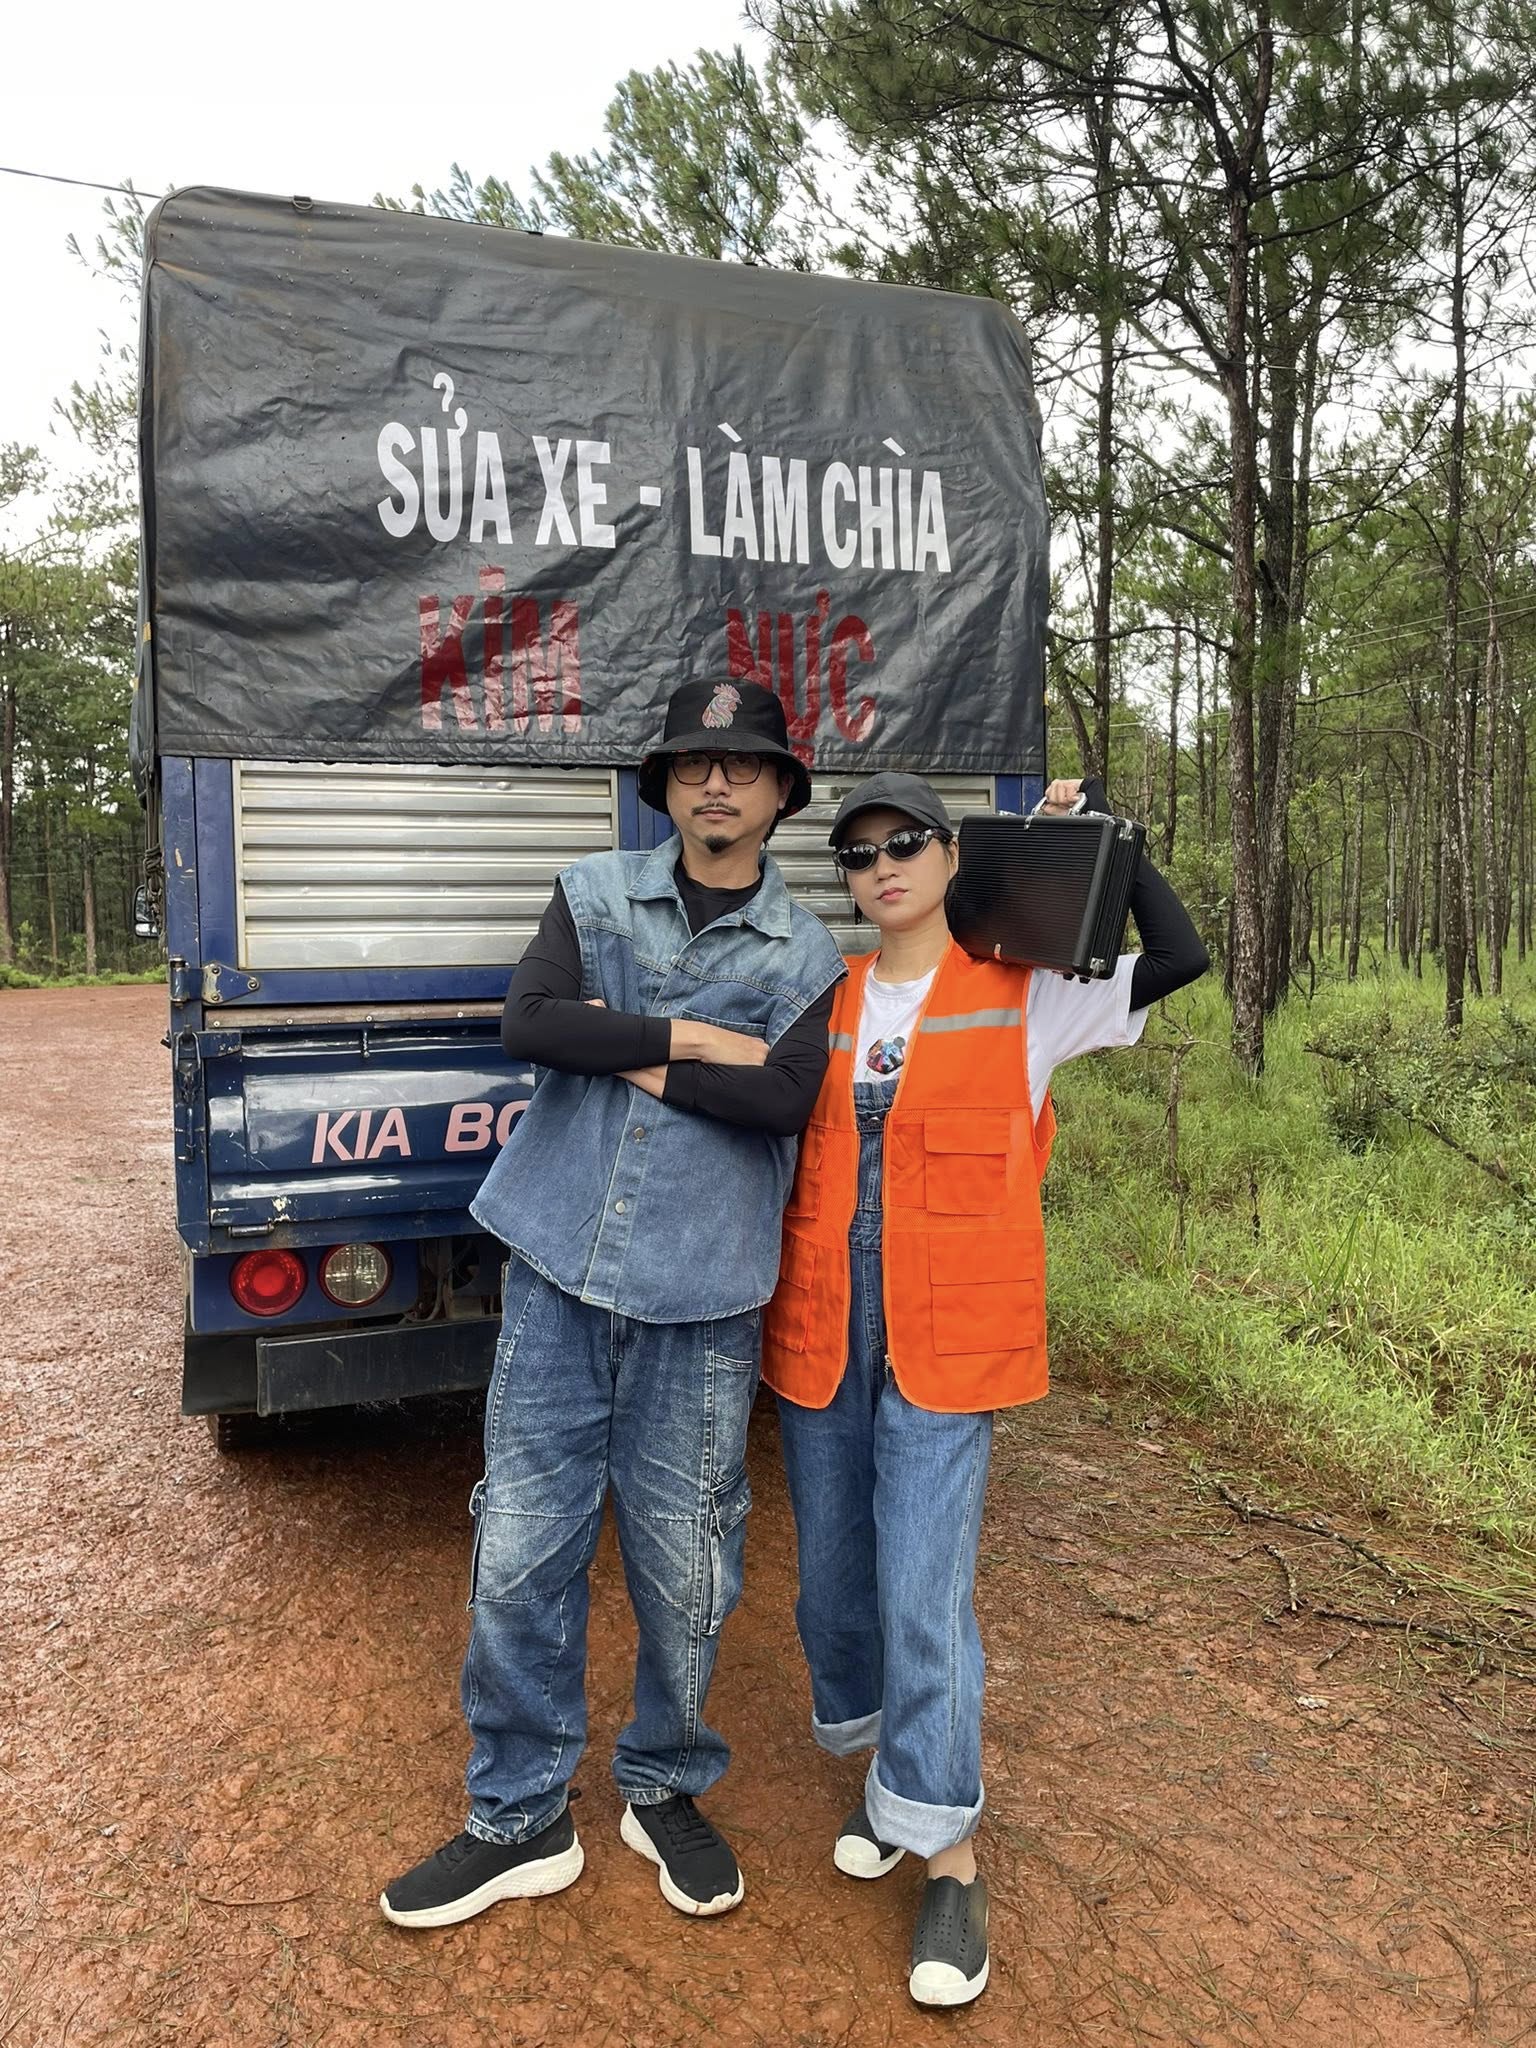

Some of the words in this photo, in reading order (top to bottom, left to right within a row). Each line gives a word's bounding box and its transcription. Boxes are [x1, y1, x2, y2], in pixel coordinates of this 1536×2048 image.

[377, 372, 513, 544] SỬA
[531, 435, 616, 549] XE
[639, 485, 662, 507] -
[687, 422, 810, 565] LÀM
[821, 437, 951, 573] CHÌA
[311, 1107, 412, 1164] KIA
